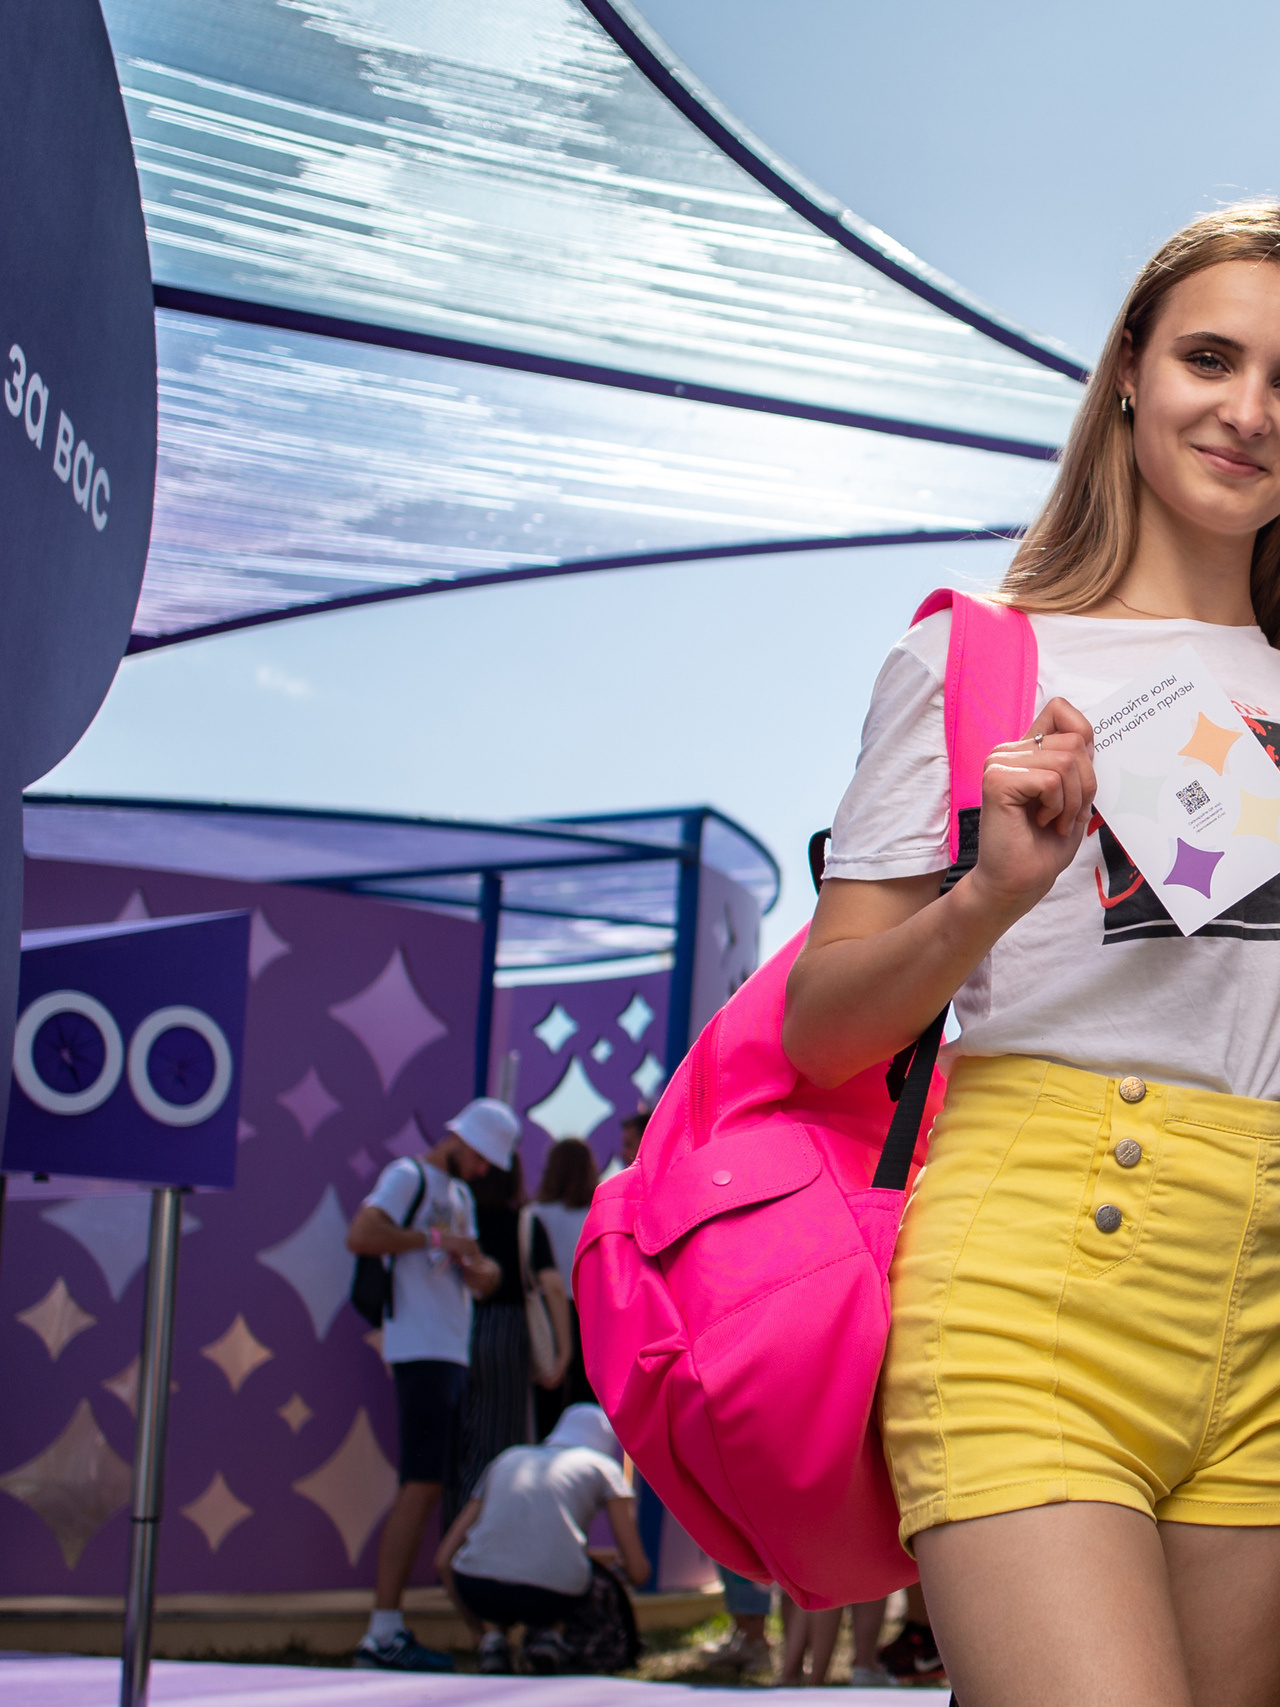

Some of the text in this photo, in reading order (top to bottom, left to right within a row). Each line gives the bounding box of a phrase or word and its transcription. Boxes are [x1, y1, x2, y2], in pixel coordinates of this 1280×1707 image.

[4, 343, 111, 532] за вас
[1093, 675, 1178, 735] обирайте юлы
[1094, 681, 1195, 753] получайте призы
